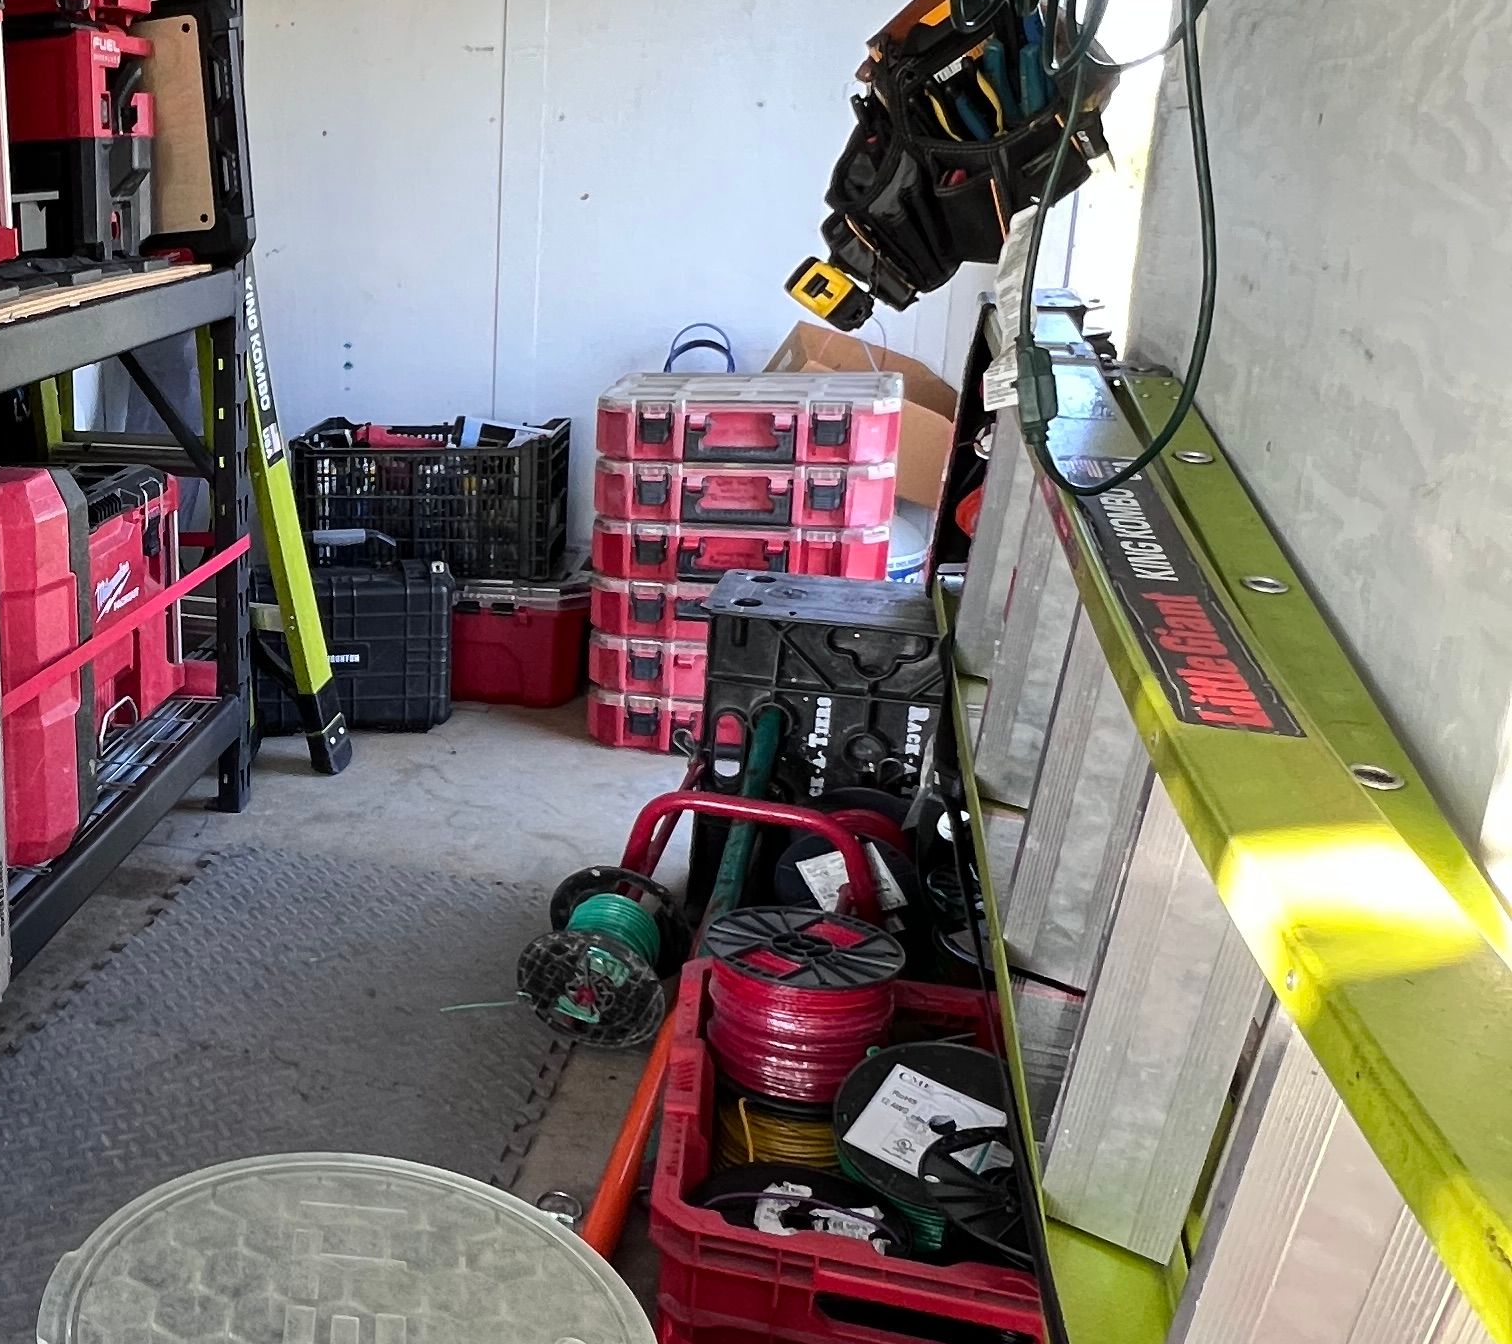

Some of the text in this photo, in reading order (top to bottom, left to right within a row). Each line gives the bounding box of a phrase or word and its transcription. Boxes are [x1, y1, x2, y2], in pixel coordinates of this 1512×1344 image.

[92, 36, 120, 53] FUEL
[249, 333, 271, 412] KOMBO
[1099, 487, 1158, 541] KOMBO
[1120, 540, 1180, 582] KING
[1140, 592, 1229, 657] Giant
[1175, 655, 1274, 729] Little
